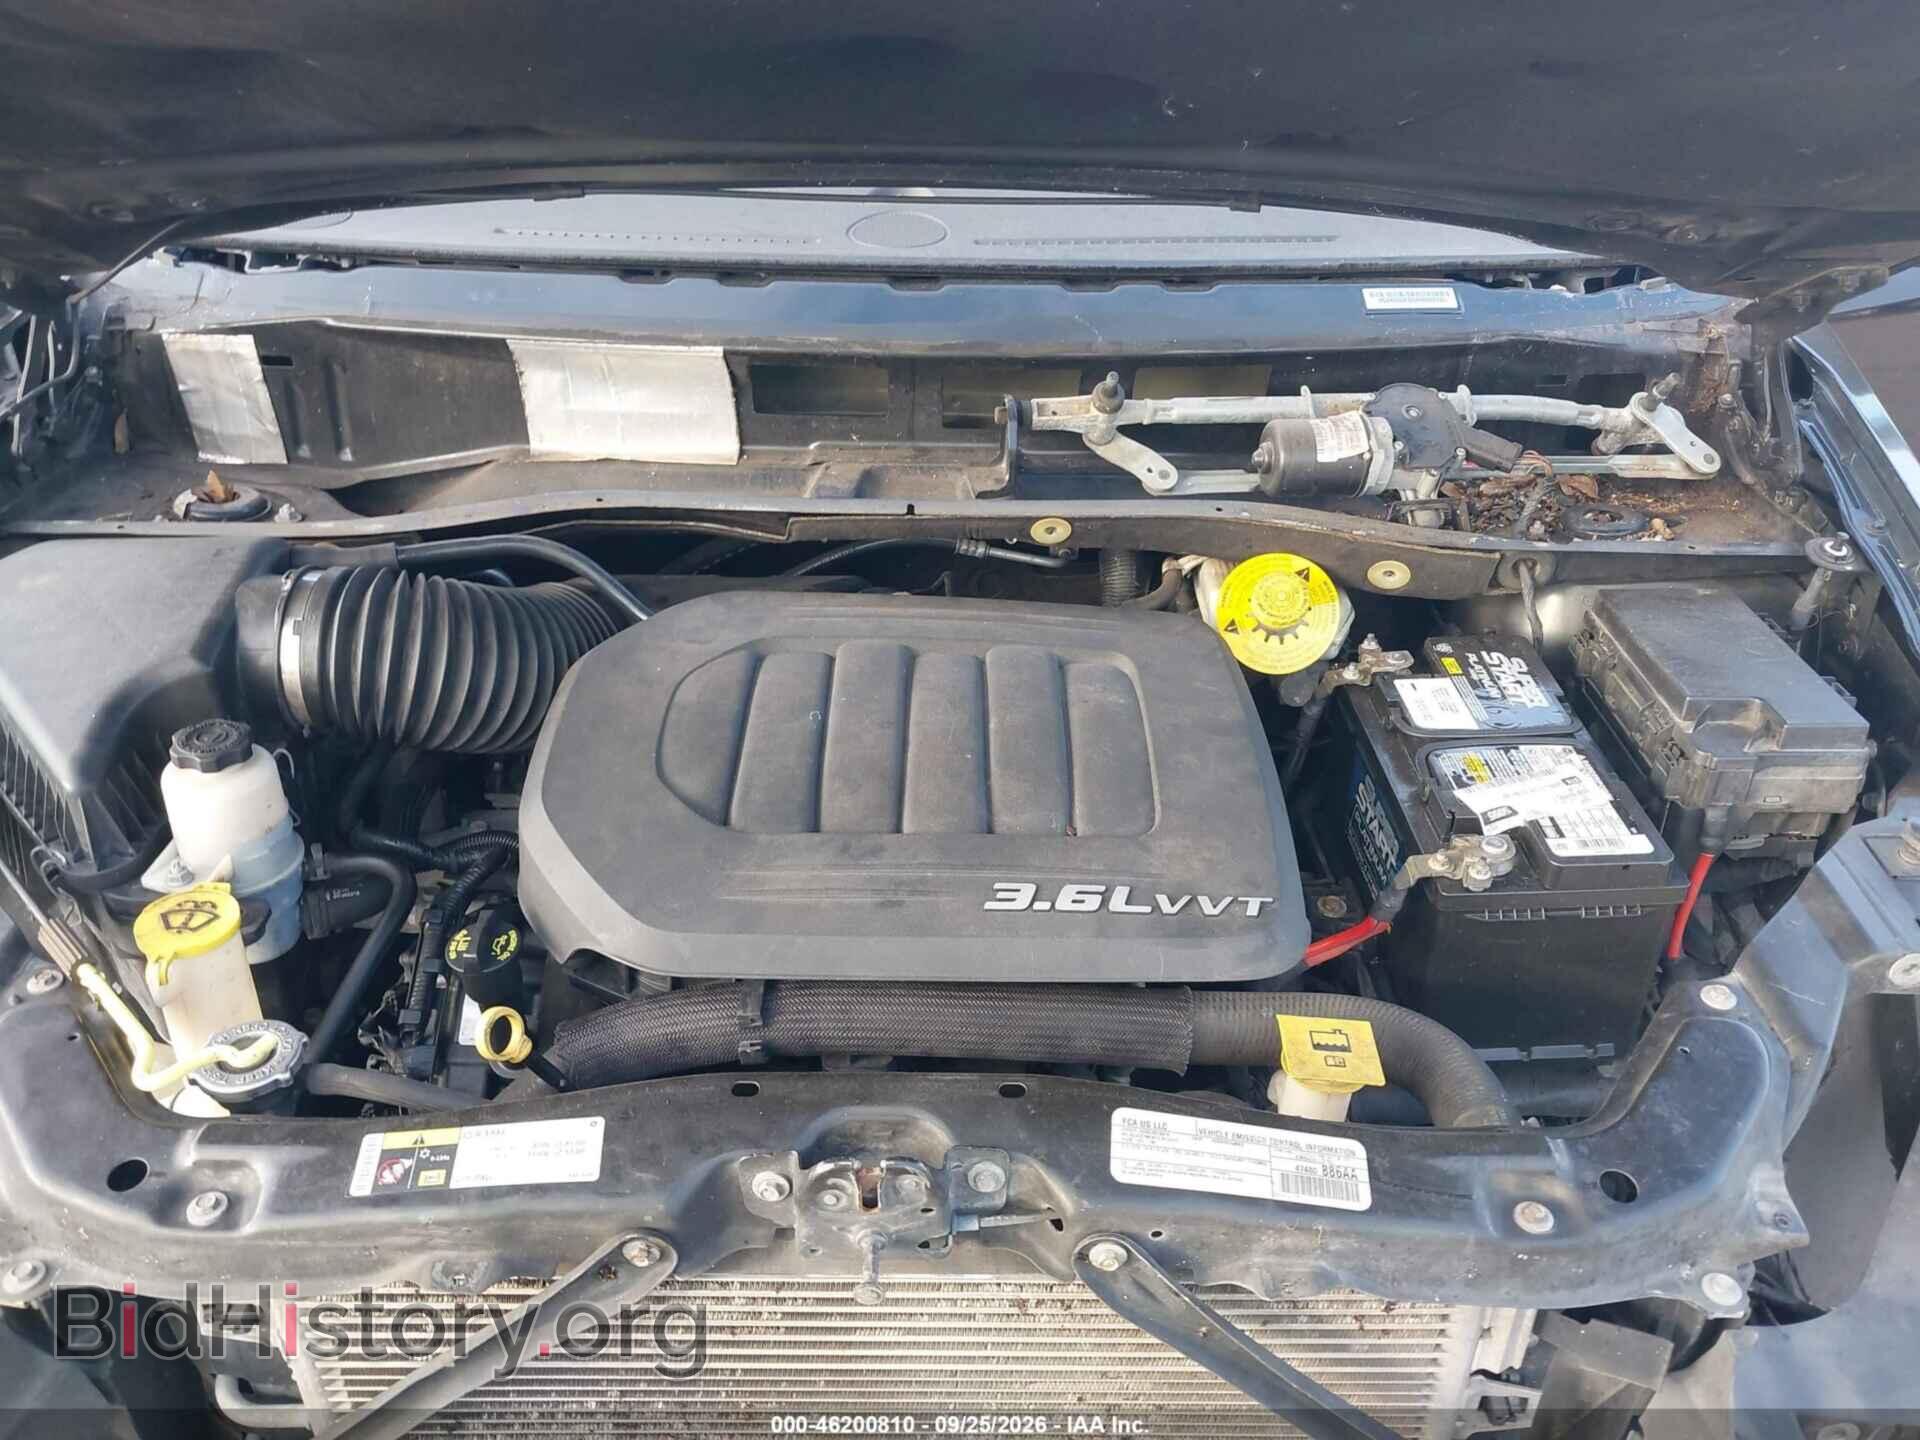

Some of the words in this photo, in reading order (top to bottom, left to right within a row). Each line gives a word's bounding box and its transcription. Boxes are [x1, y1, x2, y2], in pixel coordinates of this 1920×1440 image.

[1480, 650, 1526, 705] START
[1507, 656, 1550, 708] SUPER
[1355, 782, 1398, 870] START
[983, 882, 1153, 914] 3.6L
[1155, 892, 1275, 917] VVT
[1139, 1119, 1152, 1128] US
[1152, 1121, 1168, 1130] LLC
[1198, 1127, 1229, 1138] VEHICLE
